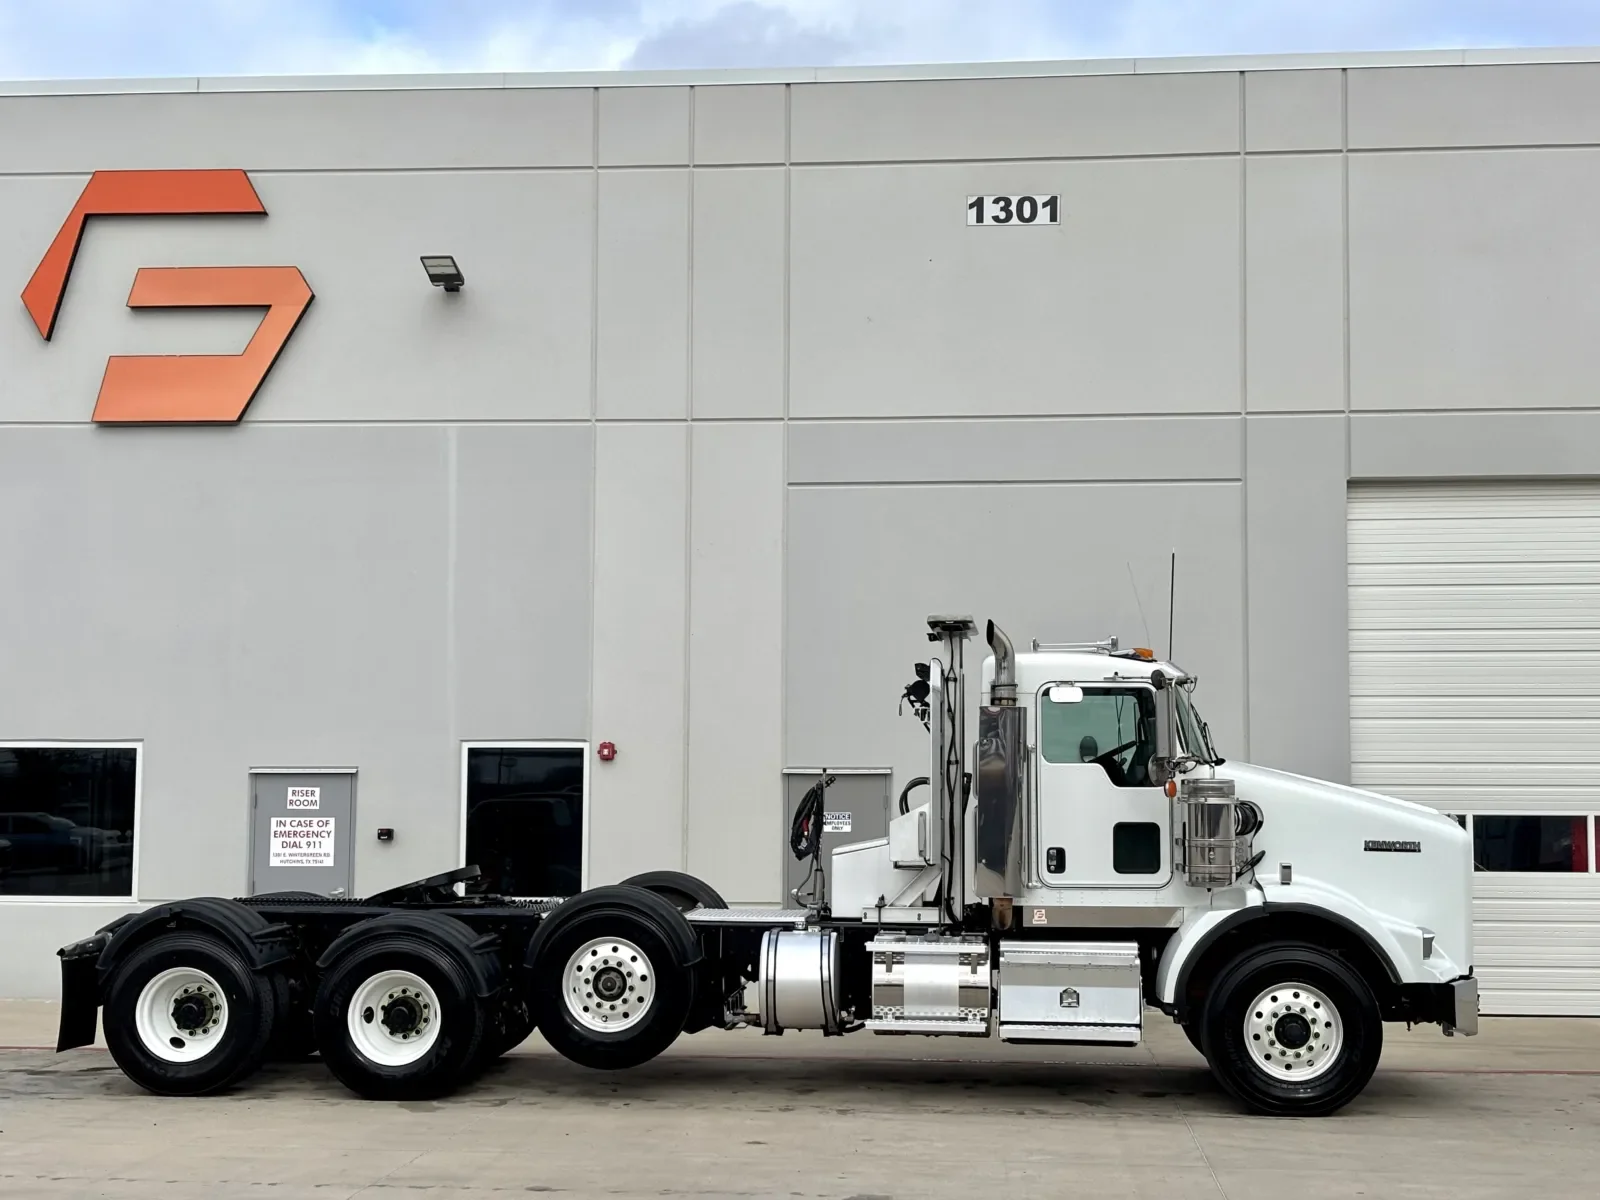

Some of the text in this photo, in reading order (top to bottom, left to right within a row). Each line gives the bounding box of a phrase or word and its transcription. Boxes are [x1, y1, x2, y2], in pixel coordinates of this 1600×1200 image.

[968, 195, 1059, 224] 1301
[291, 789, 316, 797] RISER
[288, 799, 318, 807] ROOM
[276, 820, 330, 828] IN CASE OF
[273, 830, 332, 838] EMERGENCY
[281, 841, 322, 849] DIAL 911
[1364, 840, 1421, 852] KENWORTH
